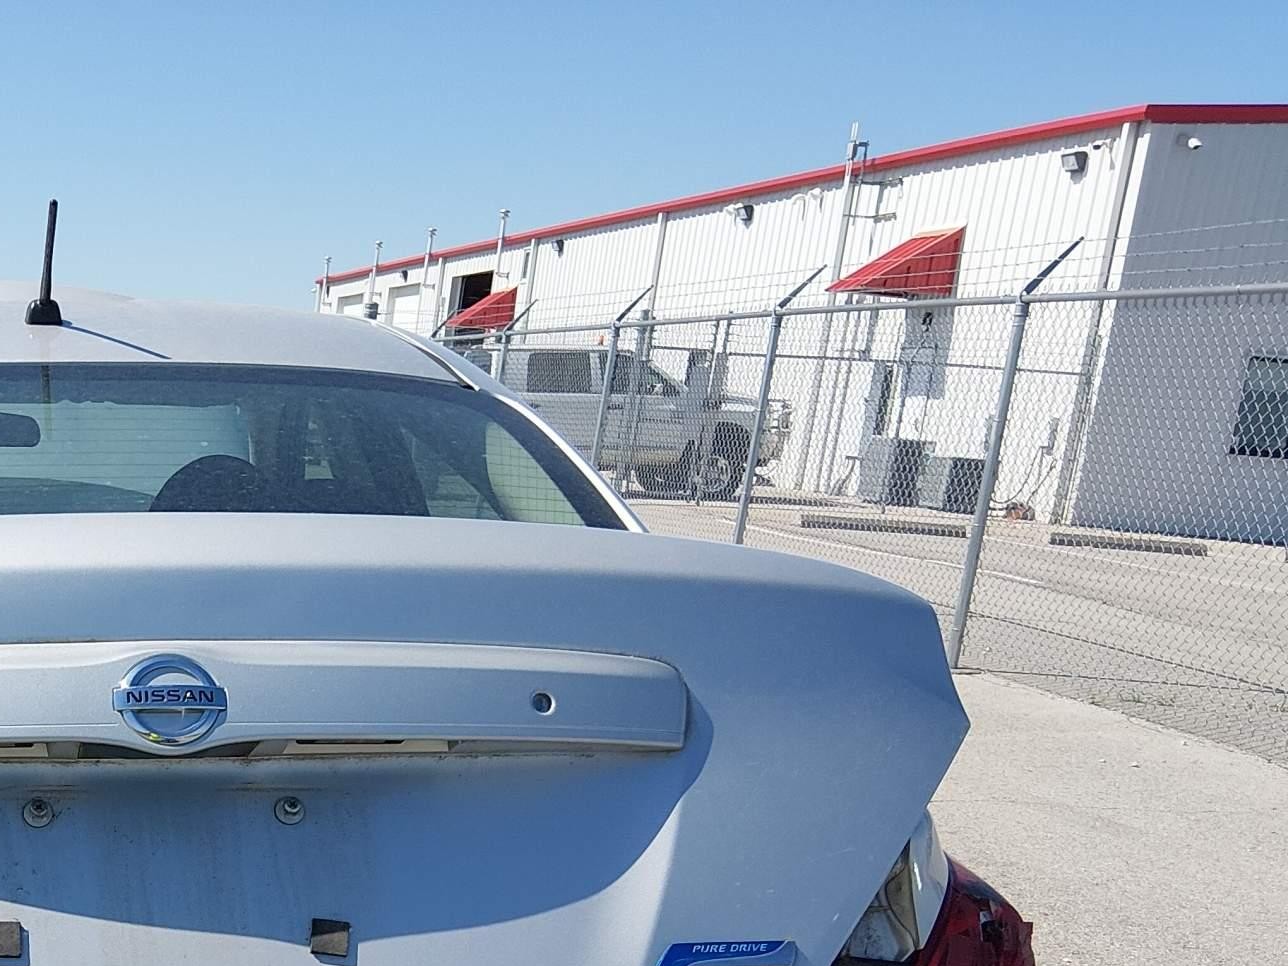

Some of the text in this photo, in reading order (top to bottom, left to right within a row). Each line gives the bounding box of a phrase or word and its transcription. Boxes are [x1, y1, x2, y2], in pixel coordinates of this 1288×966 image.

[125, 688, 215, 704] NISSAN
[692, 943, 769, 953] PURE DRIVE
